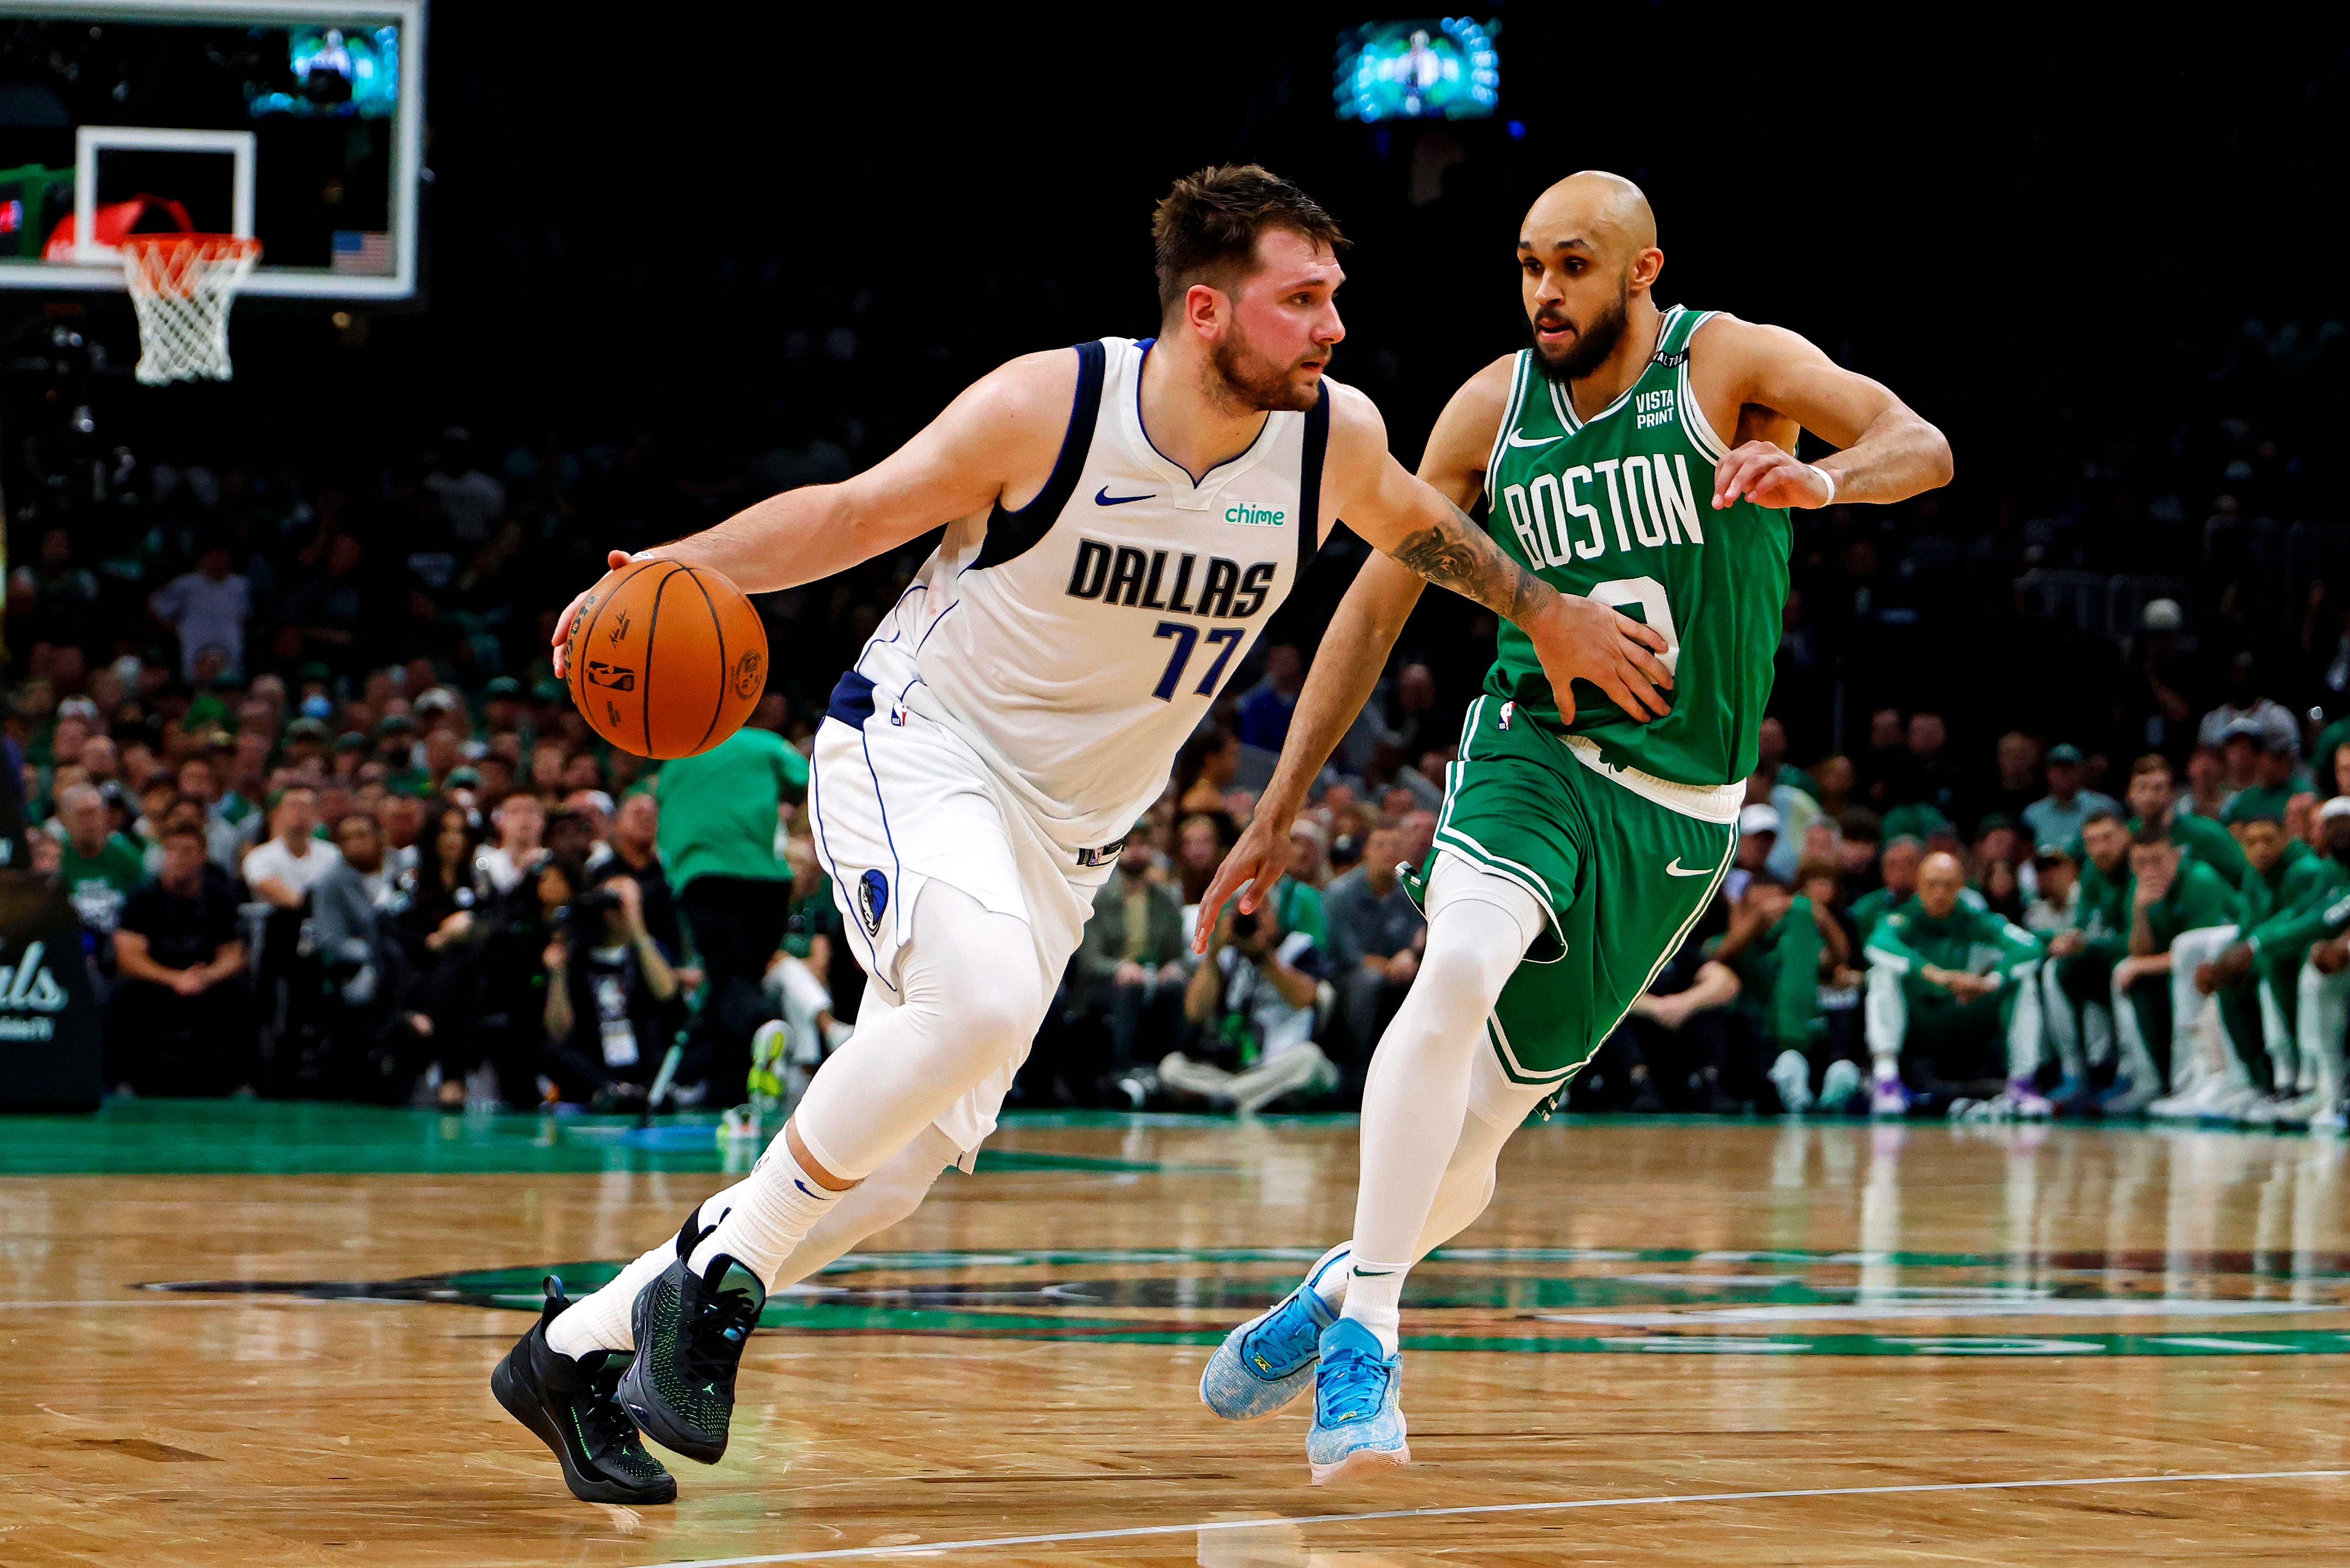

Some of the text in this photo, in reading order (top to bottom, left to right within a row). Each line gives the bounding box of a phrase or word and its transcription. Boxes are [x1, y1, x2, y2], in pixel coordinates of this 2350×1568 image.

[1636, 389, 1674, 413] VISTA
[1637, 407, 1674, 429] PRINT
[1225, 503, 1285, 525] chime
[1503, 453, 1704, 571] BOSTON
[1065, 538, 1278, 618] DALLAS
[1152, 620, 1246, 702] 77
